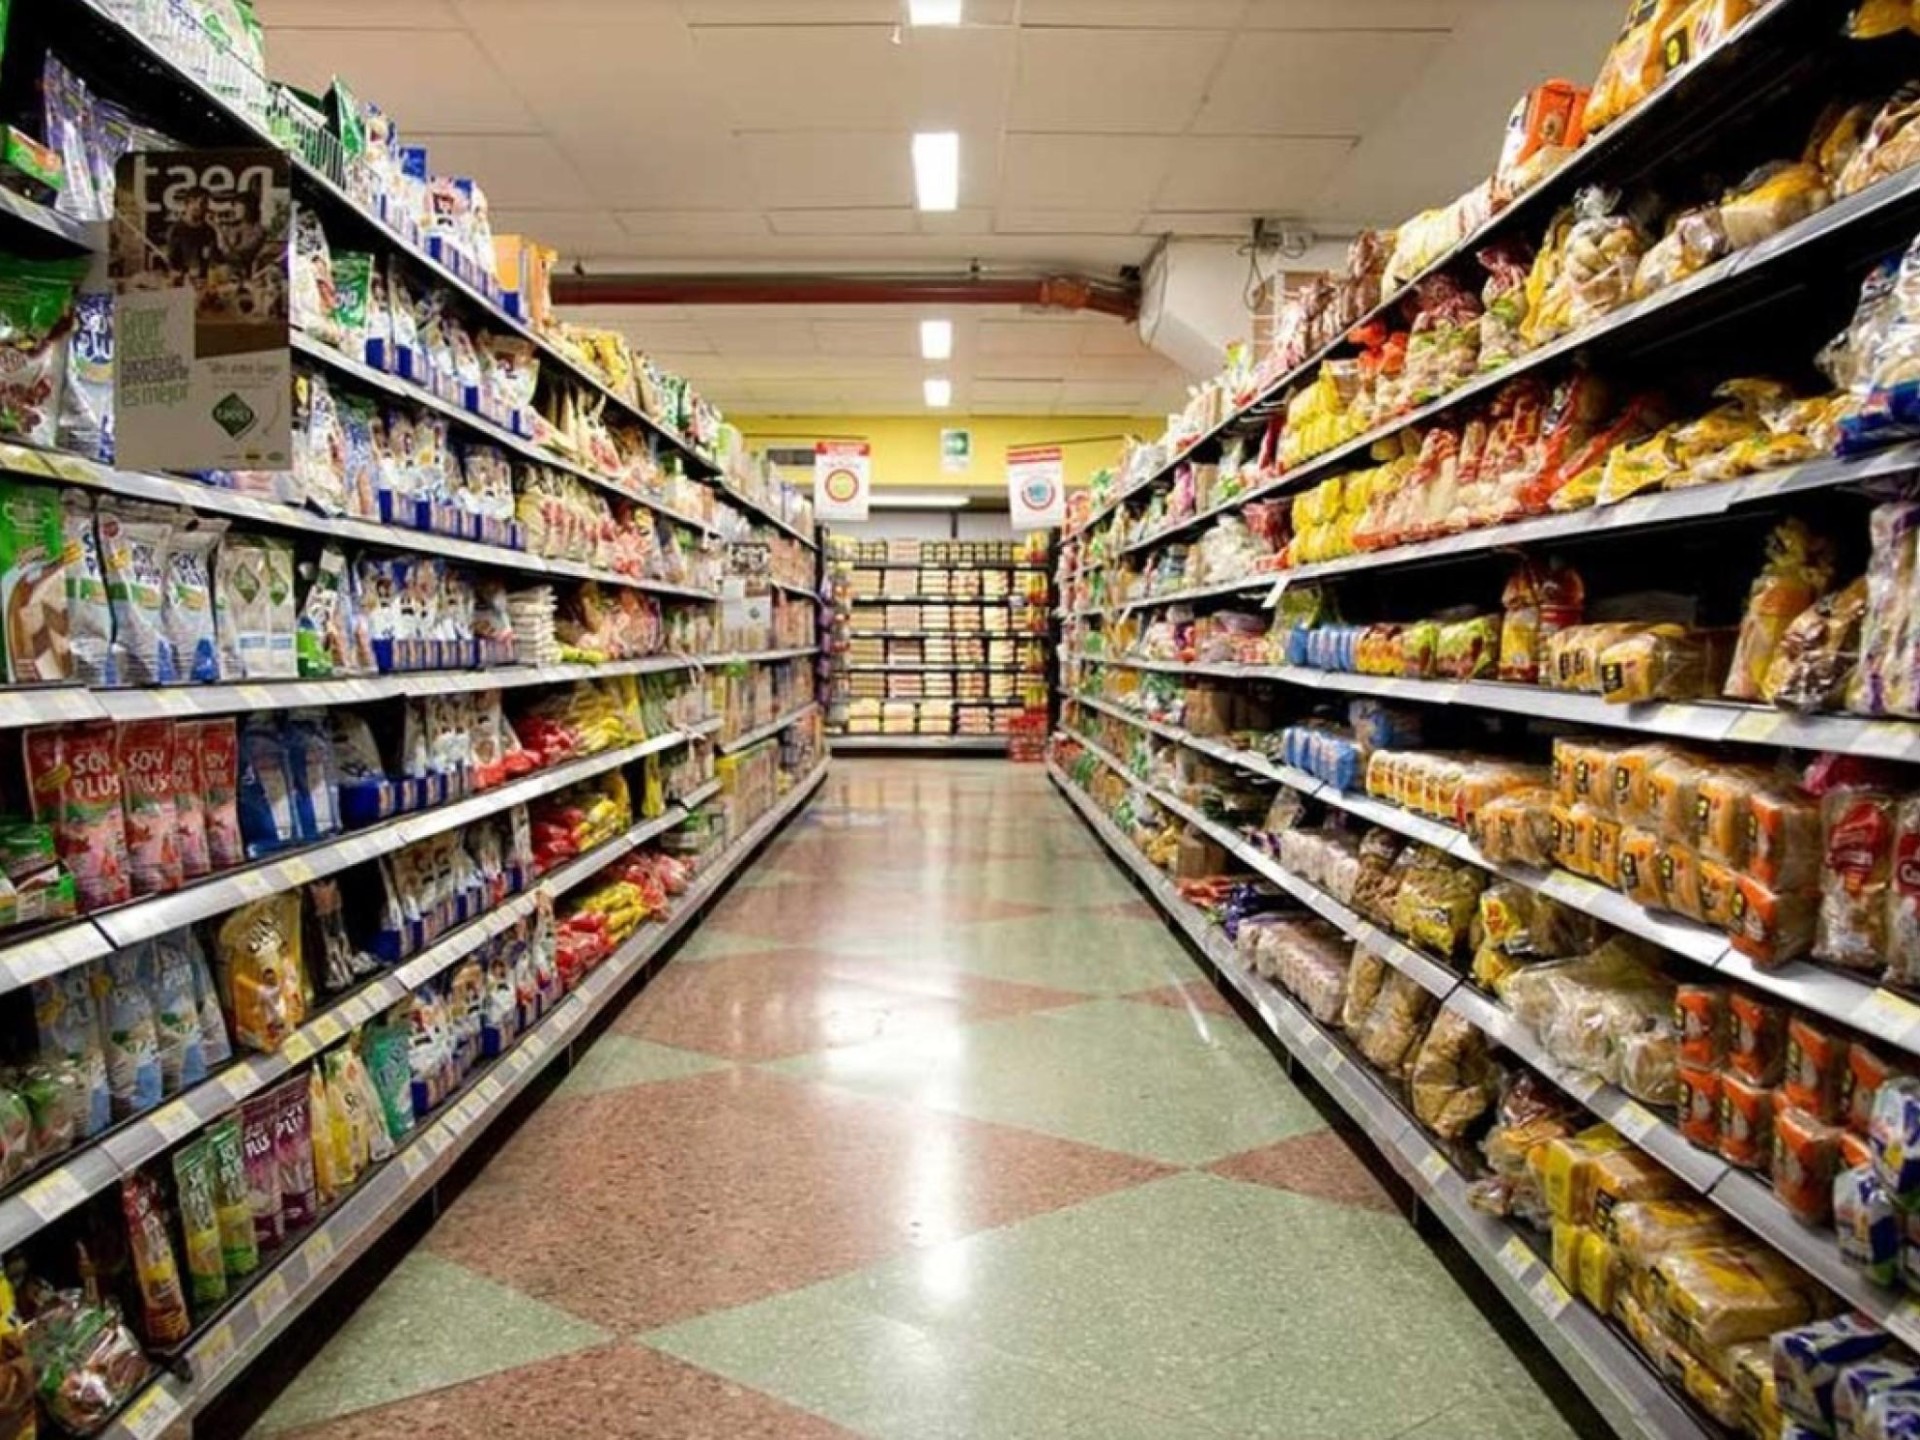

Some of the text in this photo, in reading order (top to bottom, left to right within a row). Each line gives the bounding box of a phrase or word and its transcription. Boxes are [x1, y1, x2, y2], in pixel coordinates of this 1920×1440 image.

[73, 750, 111, 777] SOY
[127, 750, 165, 772] SOY
[72, 774, 121, 799] PLUS
